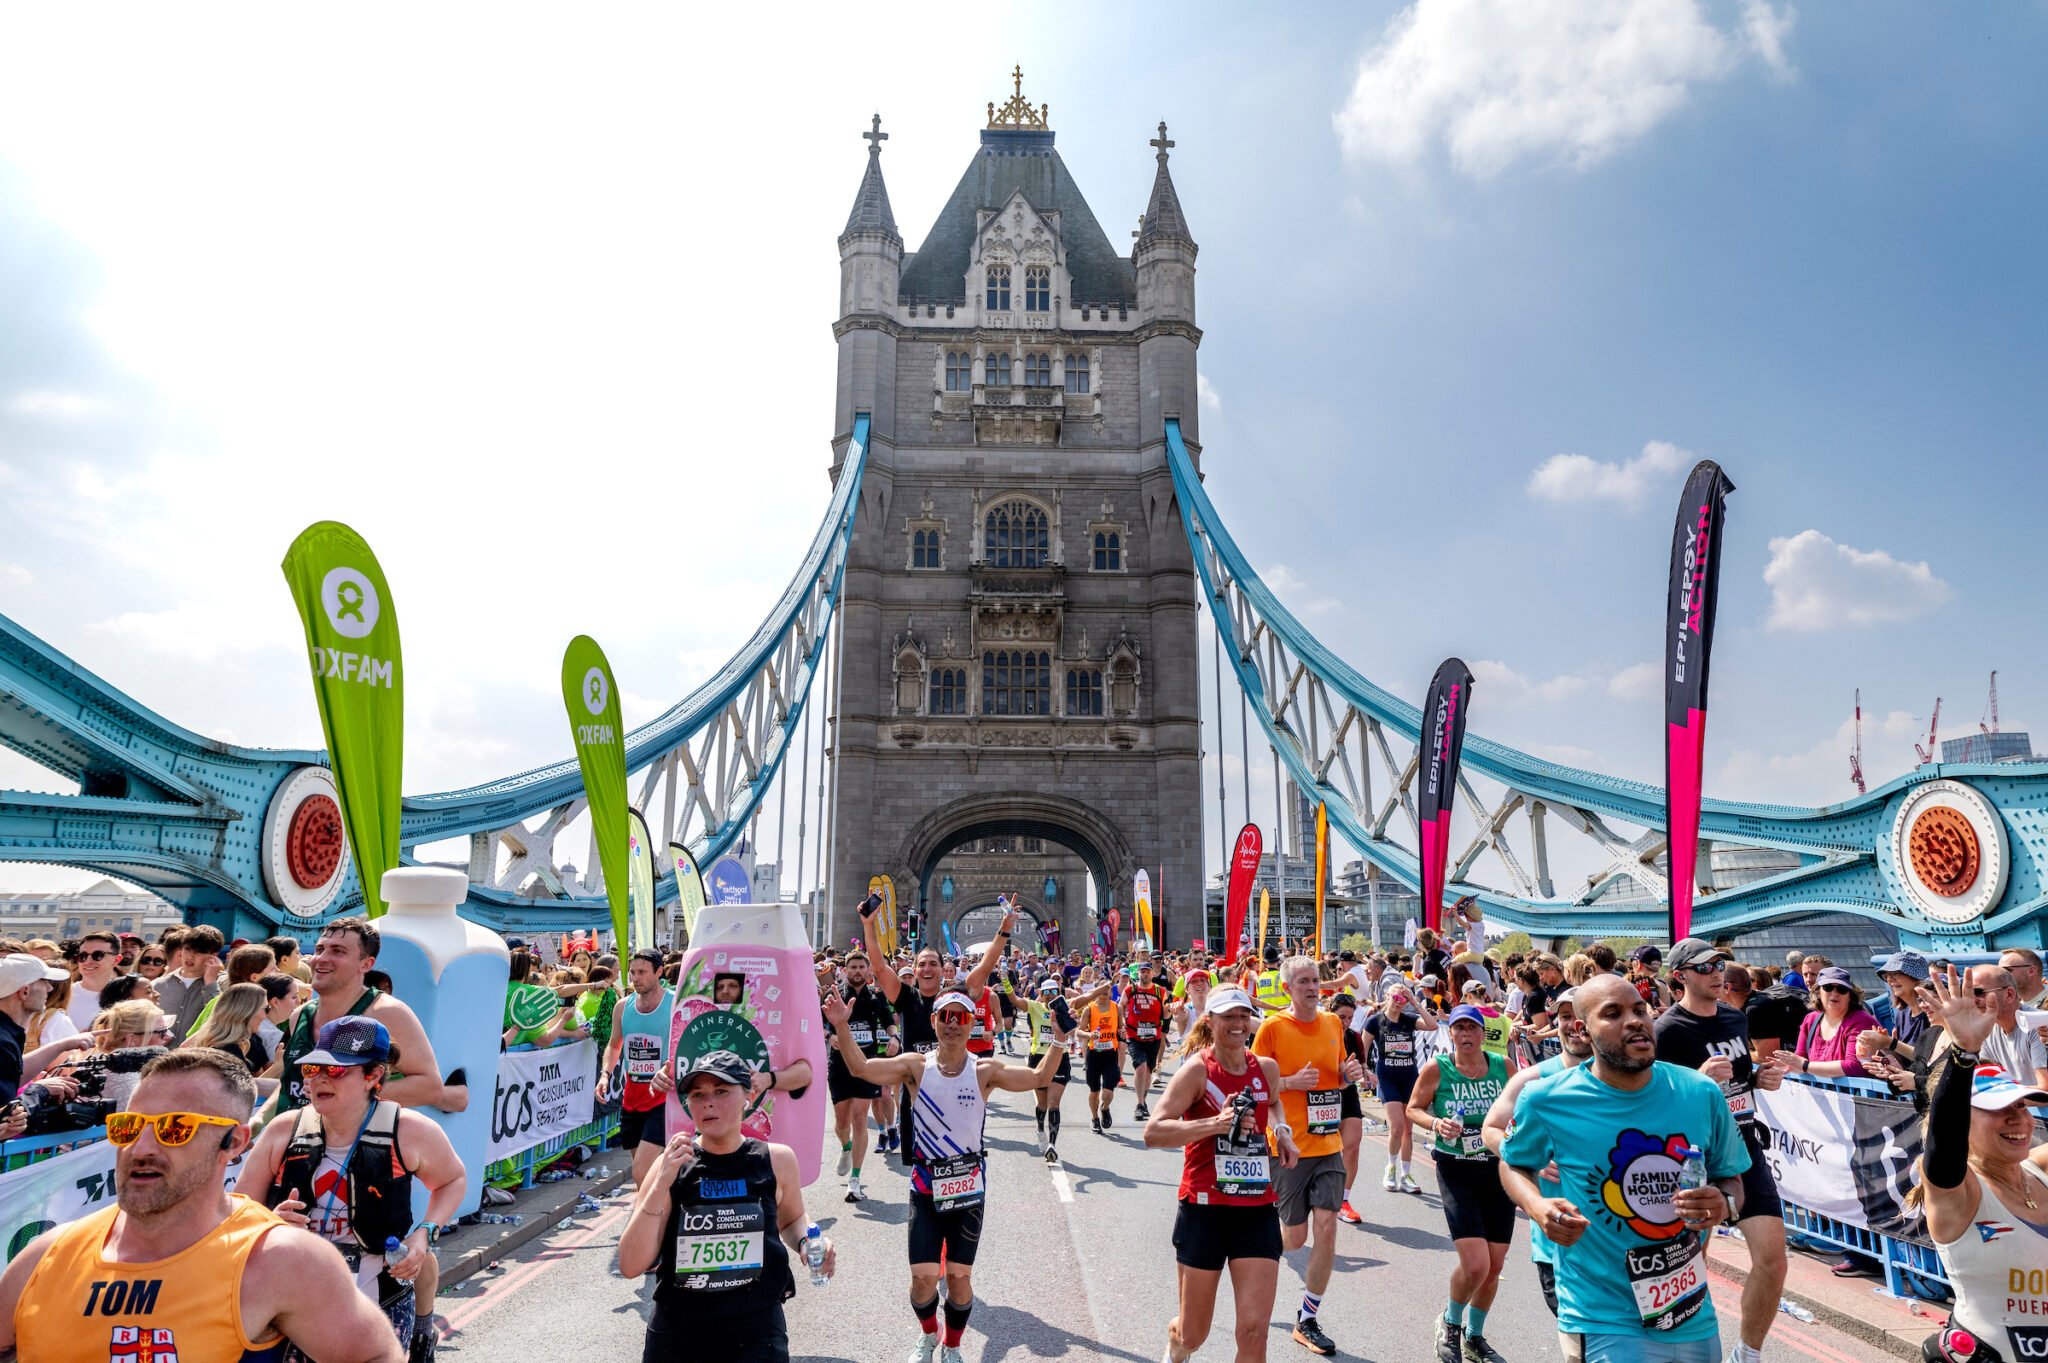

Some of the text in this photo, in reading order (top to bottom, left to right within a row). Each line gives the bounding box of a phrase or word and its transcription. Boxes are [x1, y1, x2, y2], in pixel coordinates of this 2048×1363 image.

[1688, 504, 1711, 636] ACTION
[1675, 523, 1697, 684] EPILEPSY
[1440, 683, 1461, 763] ACTION
[577, 724, 615, 745] OXFAM
[1428, 694, 1449, 795] EPILEPSY
[1274, 927, 1306, 937] Bidge
[691, 1015, 751, 1039] MINERAL
[1706, 1035, 1748, 1062] LDN
[631, 1062, 654, 1073] 24106
[1384, 1058, 1414, 1067] GEORGIA
[537, 1074, 586, 1105] CONSULTANCY
[1308, 1092, 1325, 1104] tcs
[492, 1073, 535, 1144] tcs
[539, 1062, 562, 1083] TATA
[1446, 1108, 1480, 1116] CACER
[1727, 1097, 1747, 1113] 802
[536, 1102, 568, 1128] SERVICES
[1315, 1108, 1338, 1121] 19932
[933, 1165, 953, 1178] tcs
[1224, 1160, 1263, 1177] 56303
[1631, 1171, 1681, 1185] FAMILY
[703, 1181, 739, 1197] SARAH
[940, 1178, 976, 1197] 26282
[683, 1208, 735, 1231] tcs TATA
[716, 1213, 759, 1224] CONSULTANCY
[716, 1221, 744, 1230] SERVICES
[690, 1240, 750, 1265] 75637
[1629, 1243, 1682, 1275] tcs TATA
[1666, 1238, 1698, 1261] CONSULTANCY
[1667, 1252, 1691, 1268] SERVICES
[708, 1281, 723, 1289] new
[724, 1277, 753, 1288] balance
[1648, 1264, 1697, 1309] 22365
[2009, 1267, 2048, 1296] DO
[83, 1279, 163, 1317] TOM
[1674, 1314, 1686, 1325] new
